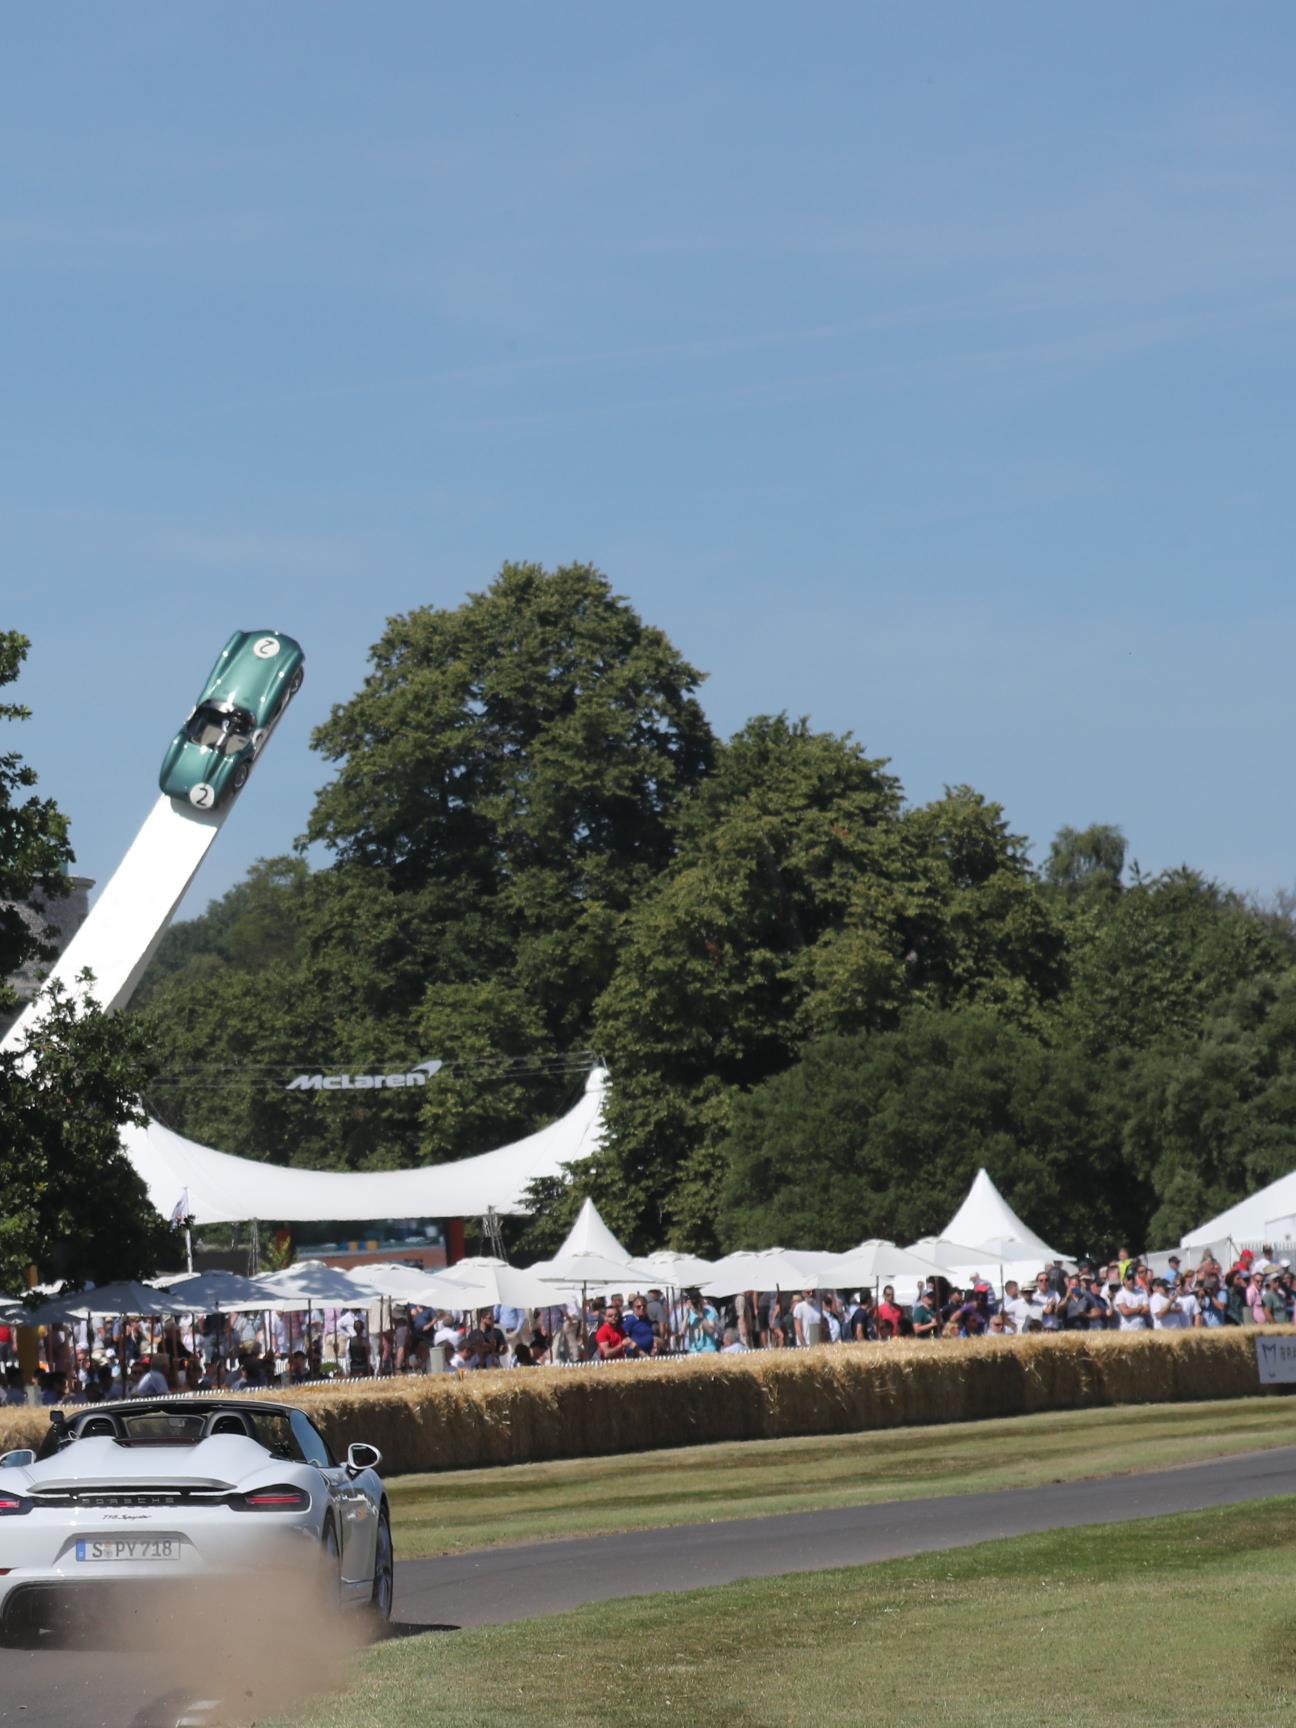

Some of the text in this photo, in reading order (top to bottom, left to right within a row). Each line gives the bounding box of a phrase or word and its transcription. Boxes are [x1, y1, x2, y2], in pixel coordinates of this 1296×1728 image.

[259, 639, 275, 655] 2
[196, 787, 209, 806] 2
[286, 1073, 425, 1090] McLaren
[92, 1541, 103, 1558] S
